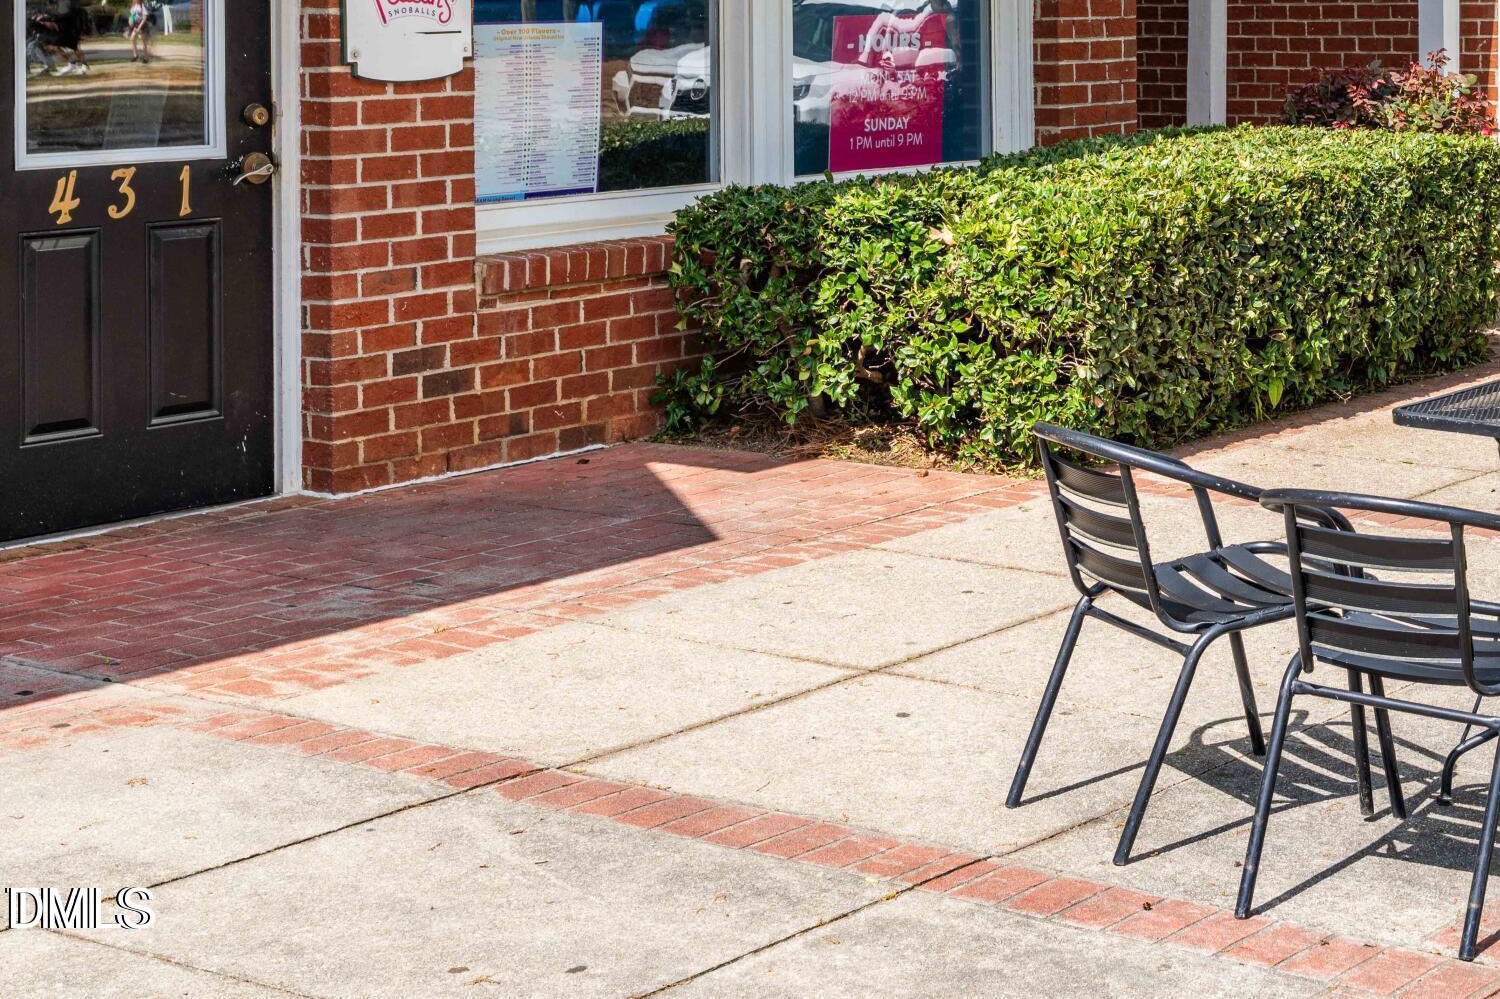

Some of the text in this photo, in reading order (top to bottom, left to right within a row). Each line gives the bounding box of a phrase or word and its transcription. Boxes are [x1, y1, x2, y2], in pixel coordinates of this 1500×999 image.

[388, 6, 436, 18] SNOBALLS
[858, 33, 921, 53] HOURS
[897, 70, 917, 83] SAT
[860, 88, 877, 102] PM
[864, 117, 910, 132] SUNDAY
[850, 132, 923, 150] 1 PM until 9 PM
